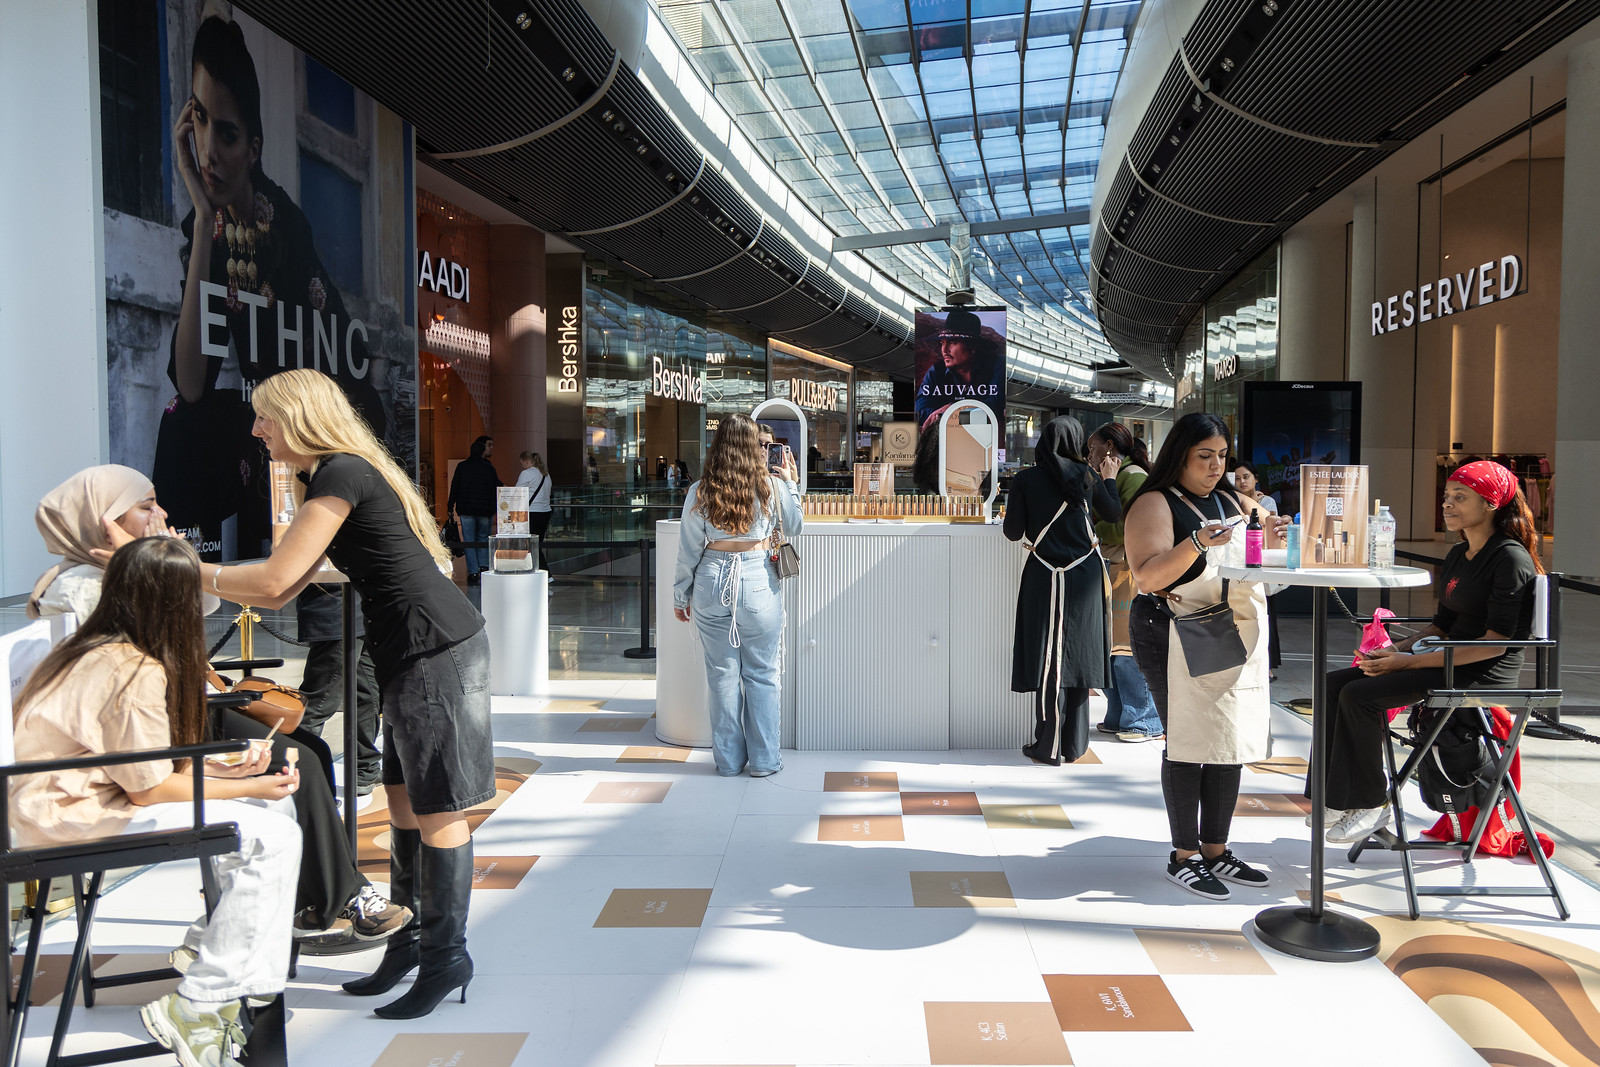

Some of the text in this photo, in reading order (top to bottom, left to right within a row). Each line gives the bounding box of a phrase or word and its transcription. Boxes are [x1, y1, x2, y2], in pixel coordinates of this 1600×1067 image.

[416, 247, 470, 303] AADI
[1371, 254, 1522, 337] RESERVED
[200, 280, 370, 380] ETHNC
[558, 305, 578, 394] Bershka
[653, 355, 703, 404] Bershka
[791, 377, 838, 412] PULL&BEAR
[922, 384, 999, 396] SAUVAGE
[1309, 470, 1360, 479] ESTÉE LAUDER
[1108, 986, 1135, 1018] Sandalwood
[994, 1021, 1008, 1041] Softan
